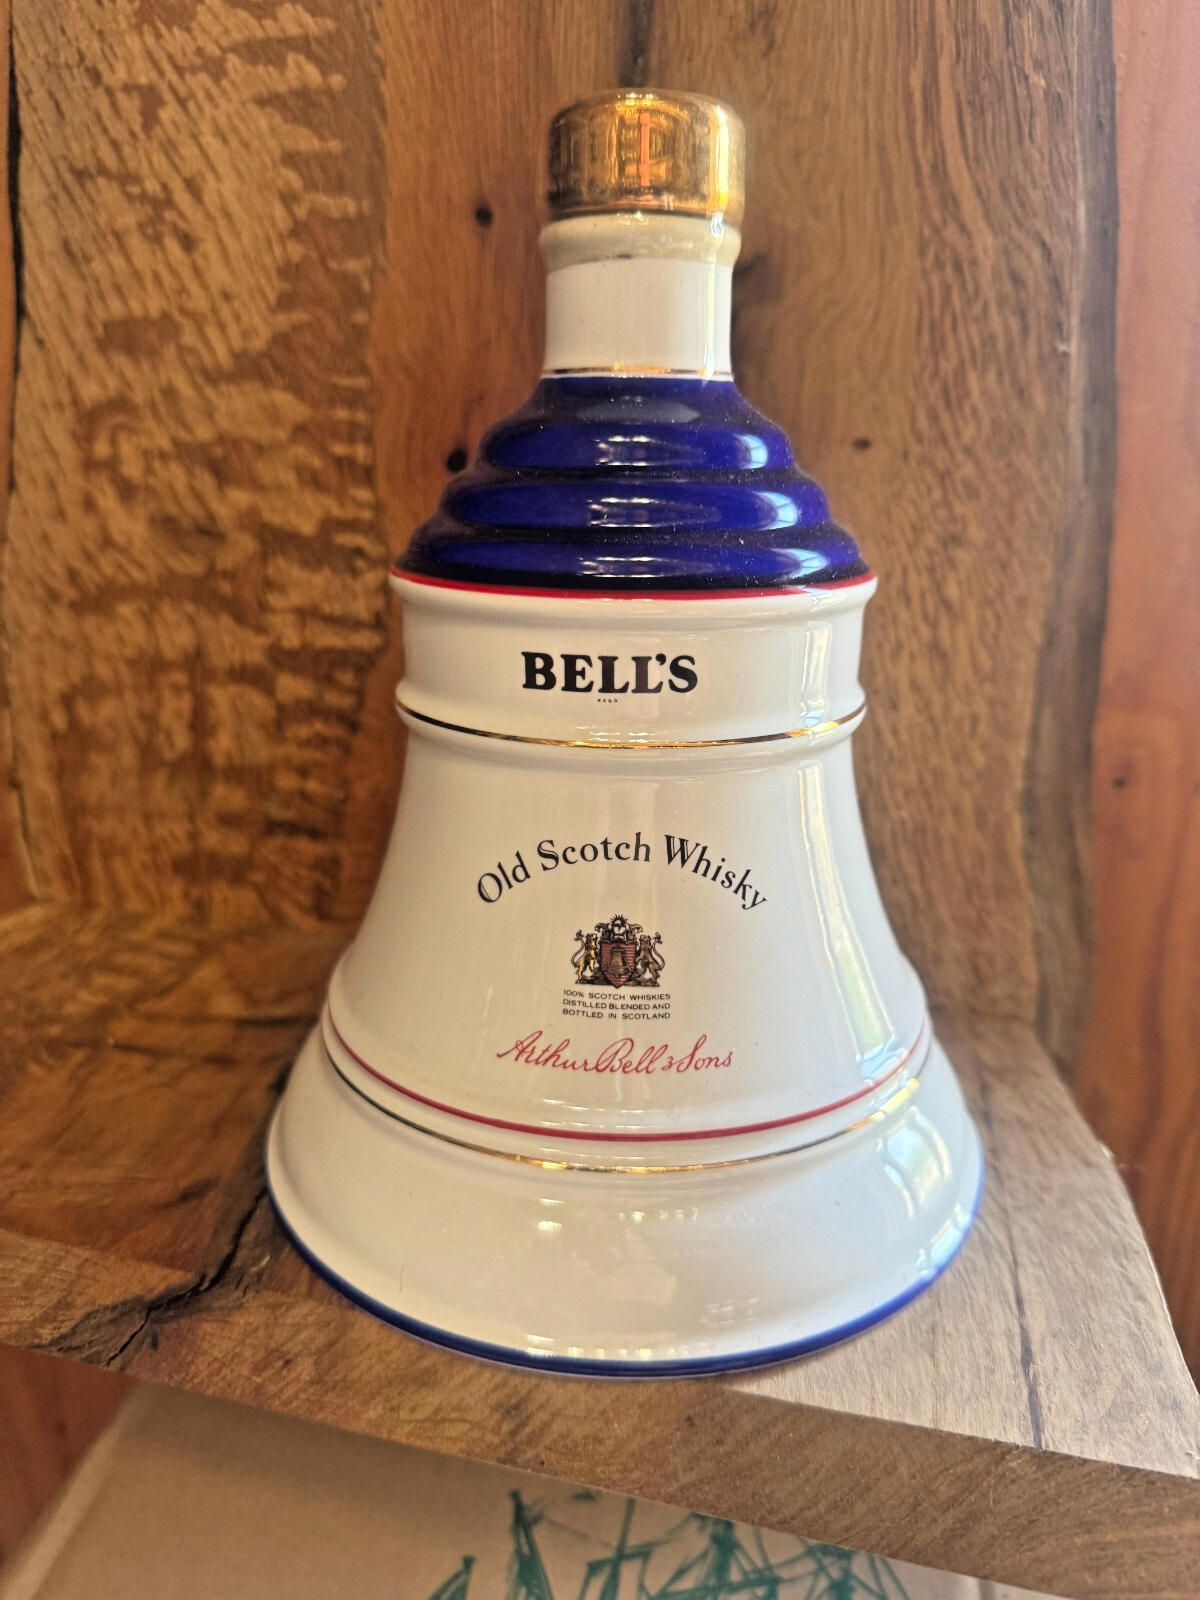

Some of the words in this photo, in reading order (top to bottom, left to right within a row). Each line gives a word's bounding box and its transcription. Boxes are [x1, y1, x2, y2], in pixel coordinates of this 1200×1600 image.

[521, 651, 698, 693] BELL'S
[477, 850, 531, 903] Old
[536, 831, 651, 871] Scotch
[664, 834, 767, 910] Whisky
[562, 998, 608, 1010] DISTILLED
[608, 1002, 651, 1011] BLENDED
[563, 989, 585, 998] 100%
[588, 992, 626, 1001] SCOTCH
[629, 993, 671, 1001] WHISKIES
[562, 1008, 604, 1019] BOTTLED
[621, 1012, 671, 1020] SCOTLAND
[496, 1030, 596, 1073] Arthur
[594, 1037, 669, 1074] Bell
[675, 1033, 733, 1073] Sons
